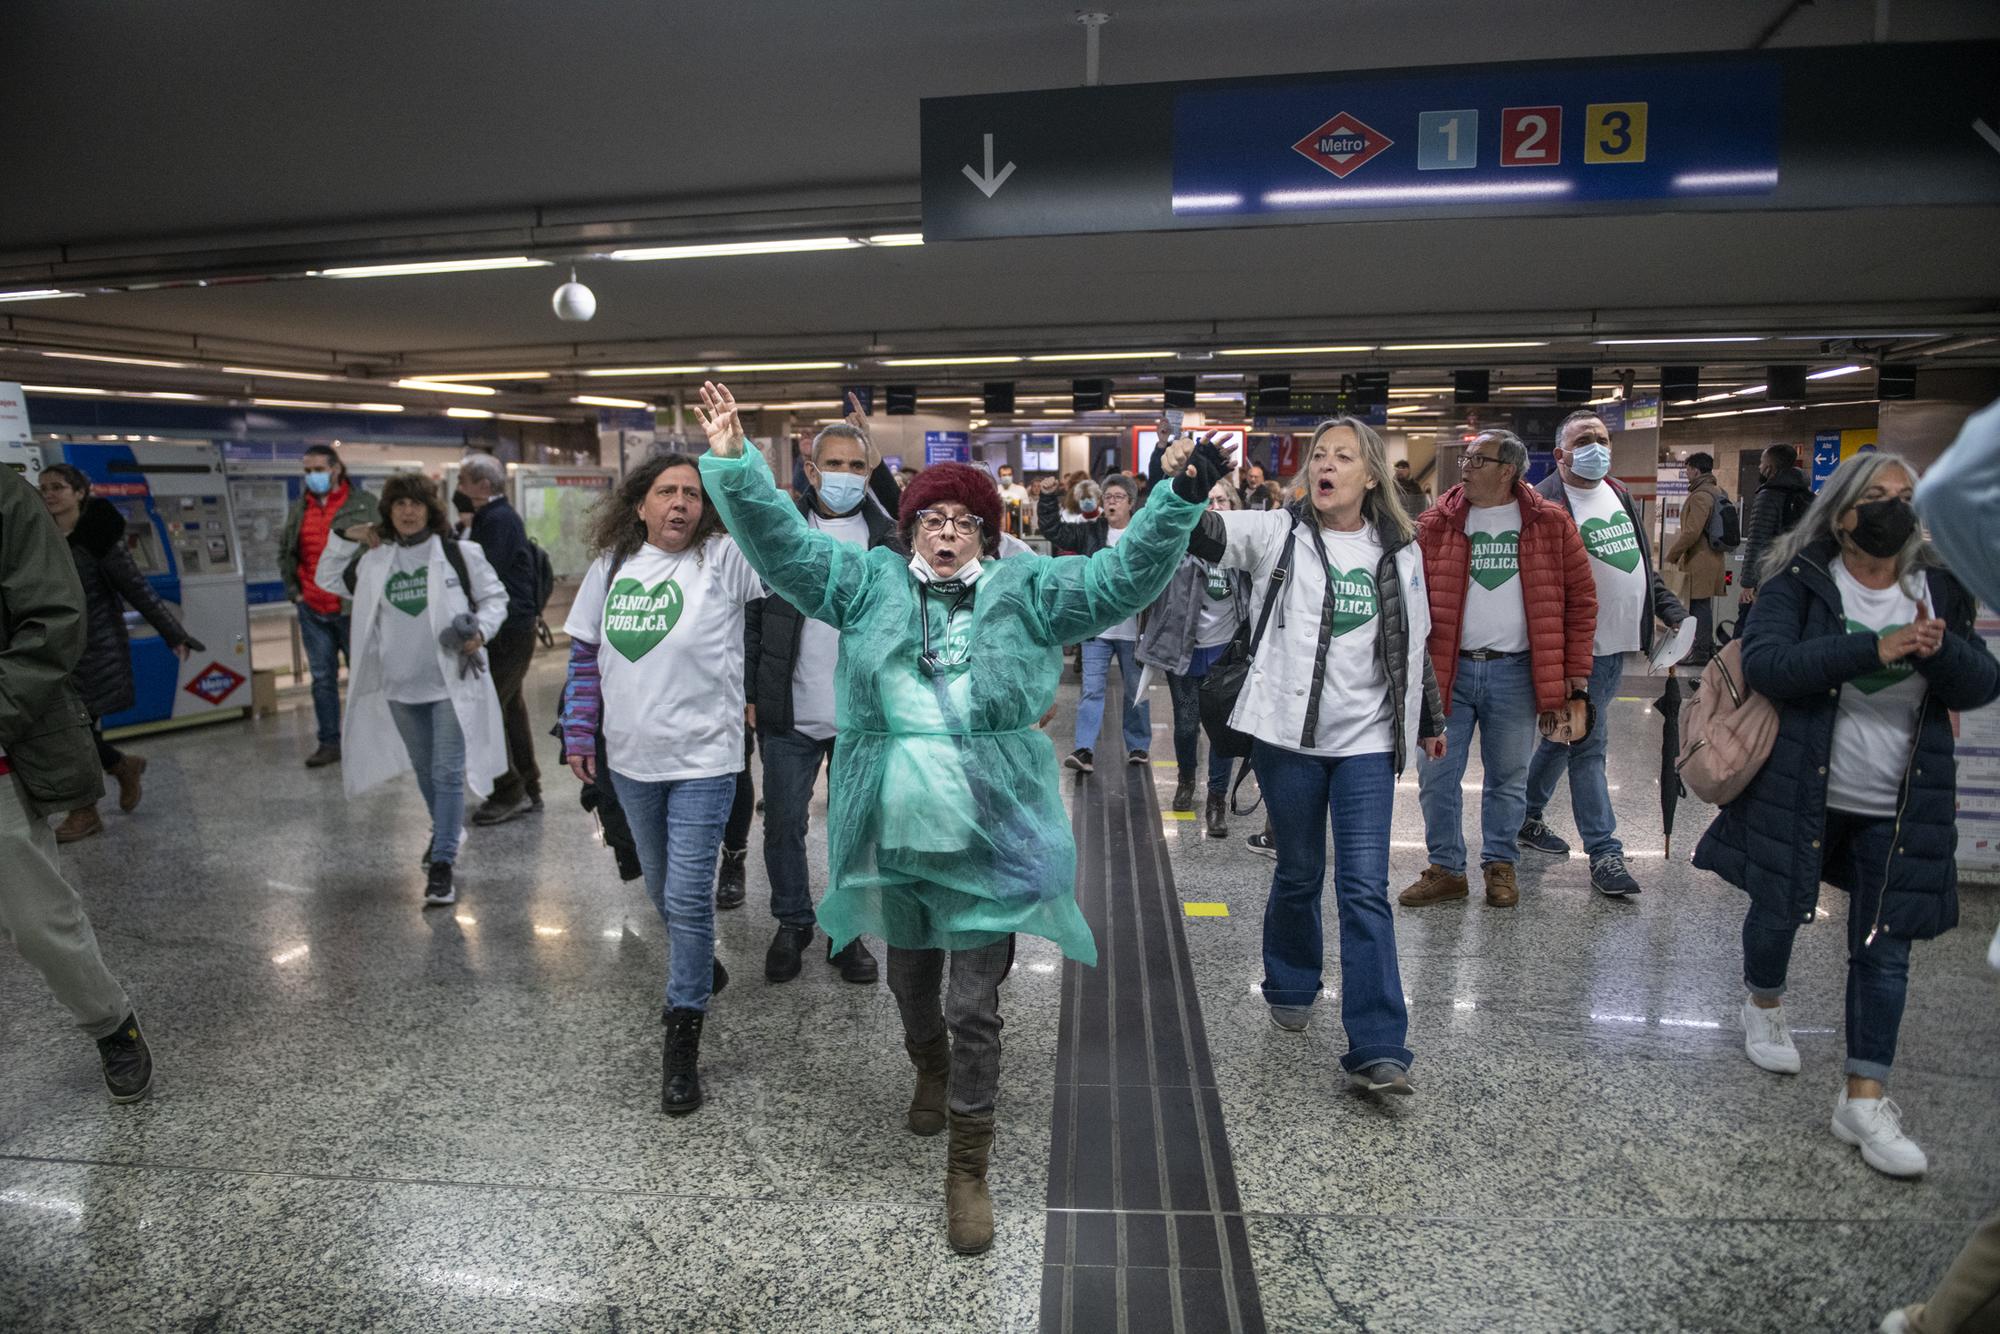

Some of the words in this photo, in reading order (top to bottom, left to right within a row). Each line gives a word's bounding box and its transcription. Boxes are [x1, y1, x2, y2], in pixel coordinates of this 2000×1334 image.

[1321, 138, 1363, 152] Metro
[1439, 118, 1459, 161] 1
[1515, 114, 1549, 159] 2
[1599, 110, 1632, 155] 3
[1282, 432, 1293, 466] 2
[31, 458, 41, 472] 3
[1588, 521, 1635, 544] SANIDAD
[1471, 542, 1519, 555] ANIDAD
[1594, 537, 1640, 558] PÚBLICA
[391, 577, 428, 591] SANIDA
[1331, 580, 1372, 597] NIDAD
[611, 593, 669, 612] SANIDAD
[606, 610, 668, 632] PÚBLICA
